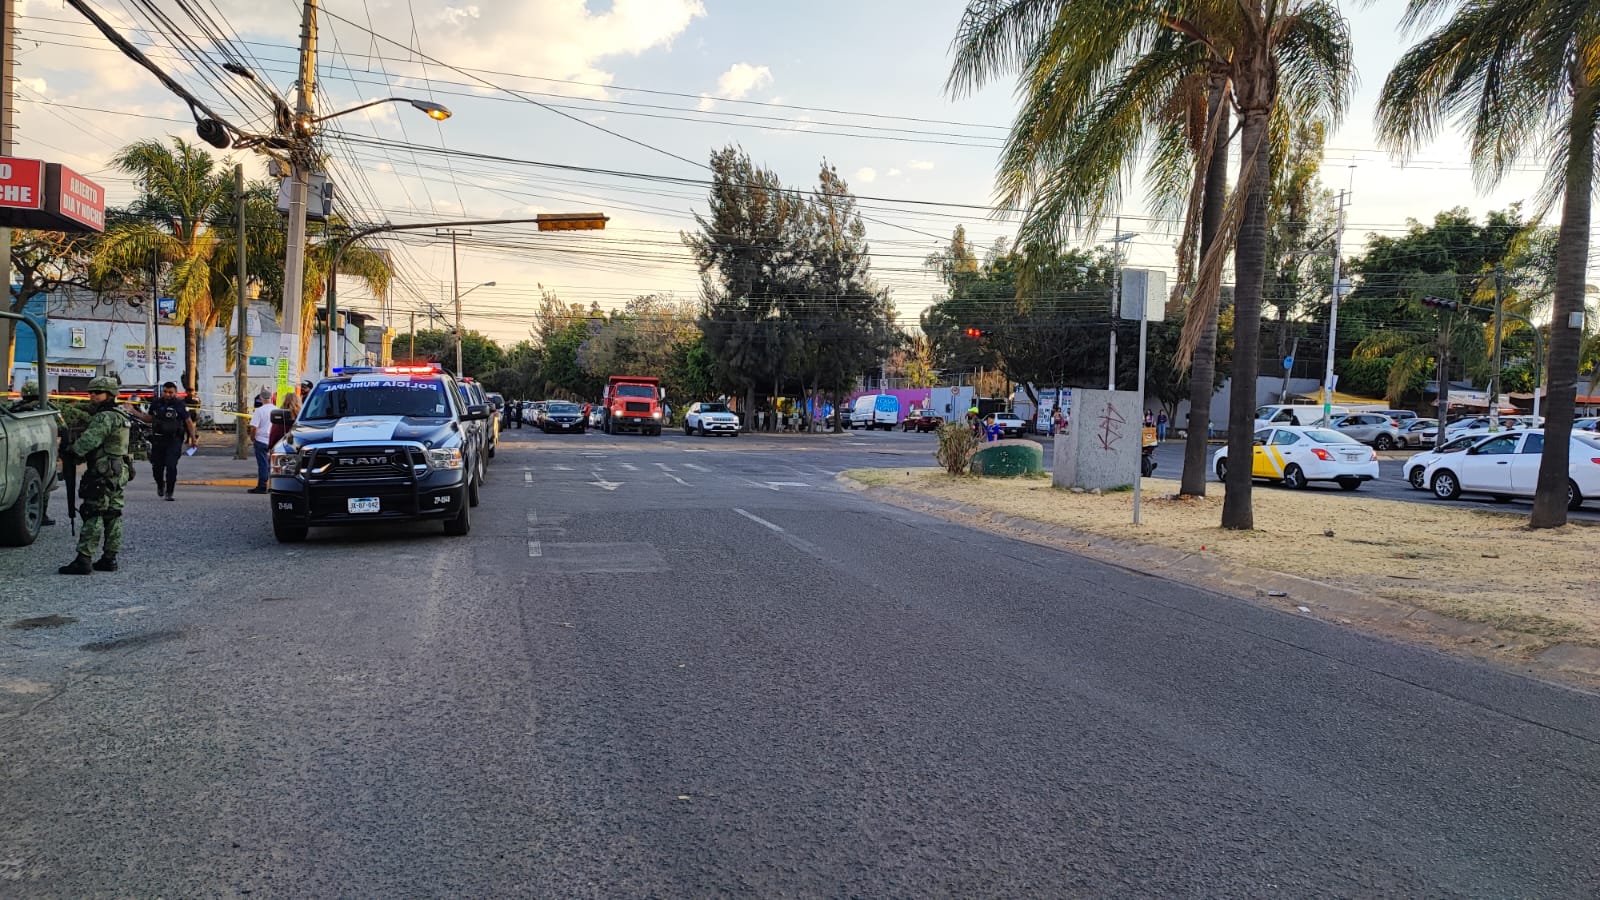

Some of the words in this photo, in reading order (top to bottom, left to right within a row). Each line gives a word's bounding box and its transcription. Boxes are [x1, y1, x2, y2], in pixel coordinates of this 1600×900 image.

[0, 185, 32, 203] HE
[70, 177, 98, 204] ABIERTO
[63, 193, 76, 213] DIA
[81, 203, 103, 226] NOCHE
[339, 456, 387, 465] RAM
